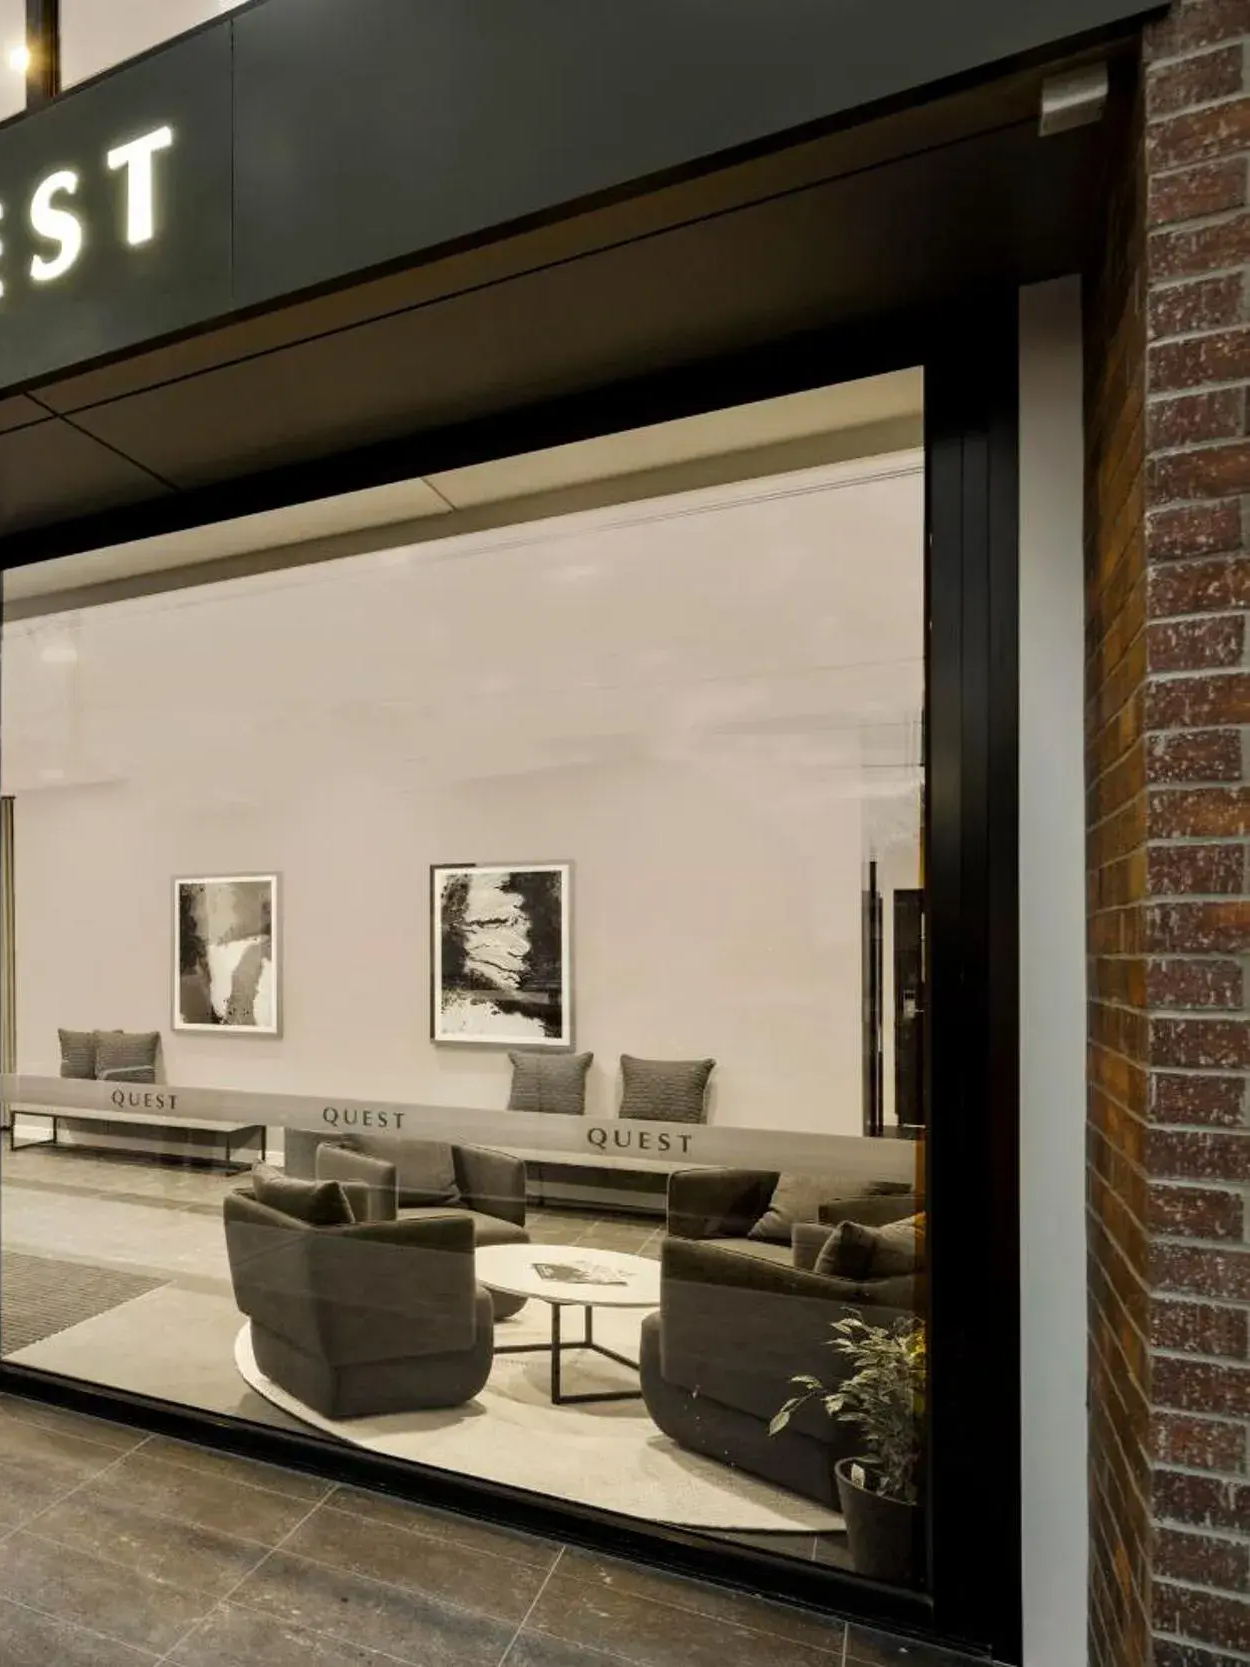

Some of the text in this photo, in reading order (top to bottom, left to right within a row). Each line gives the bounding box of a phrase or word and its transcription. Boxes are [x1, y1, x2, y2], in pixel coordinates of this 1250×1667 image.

[111, 1088, 177, 1110] QUEST
[323, 1107, 405, 1129] QUEST
[587, 1127, 692, 1153] QUEST
